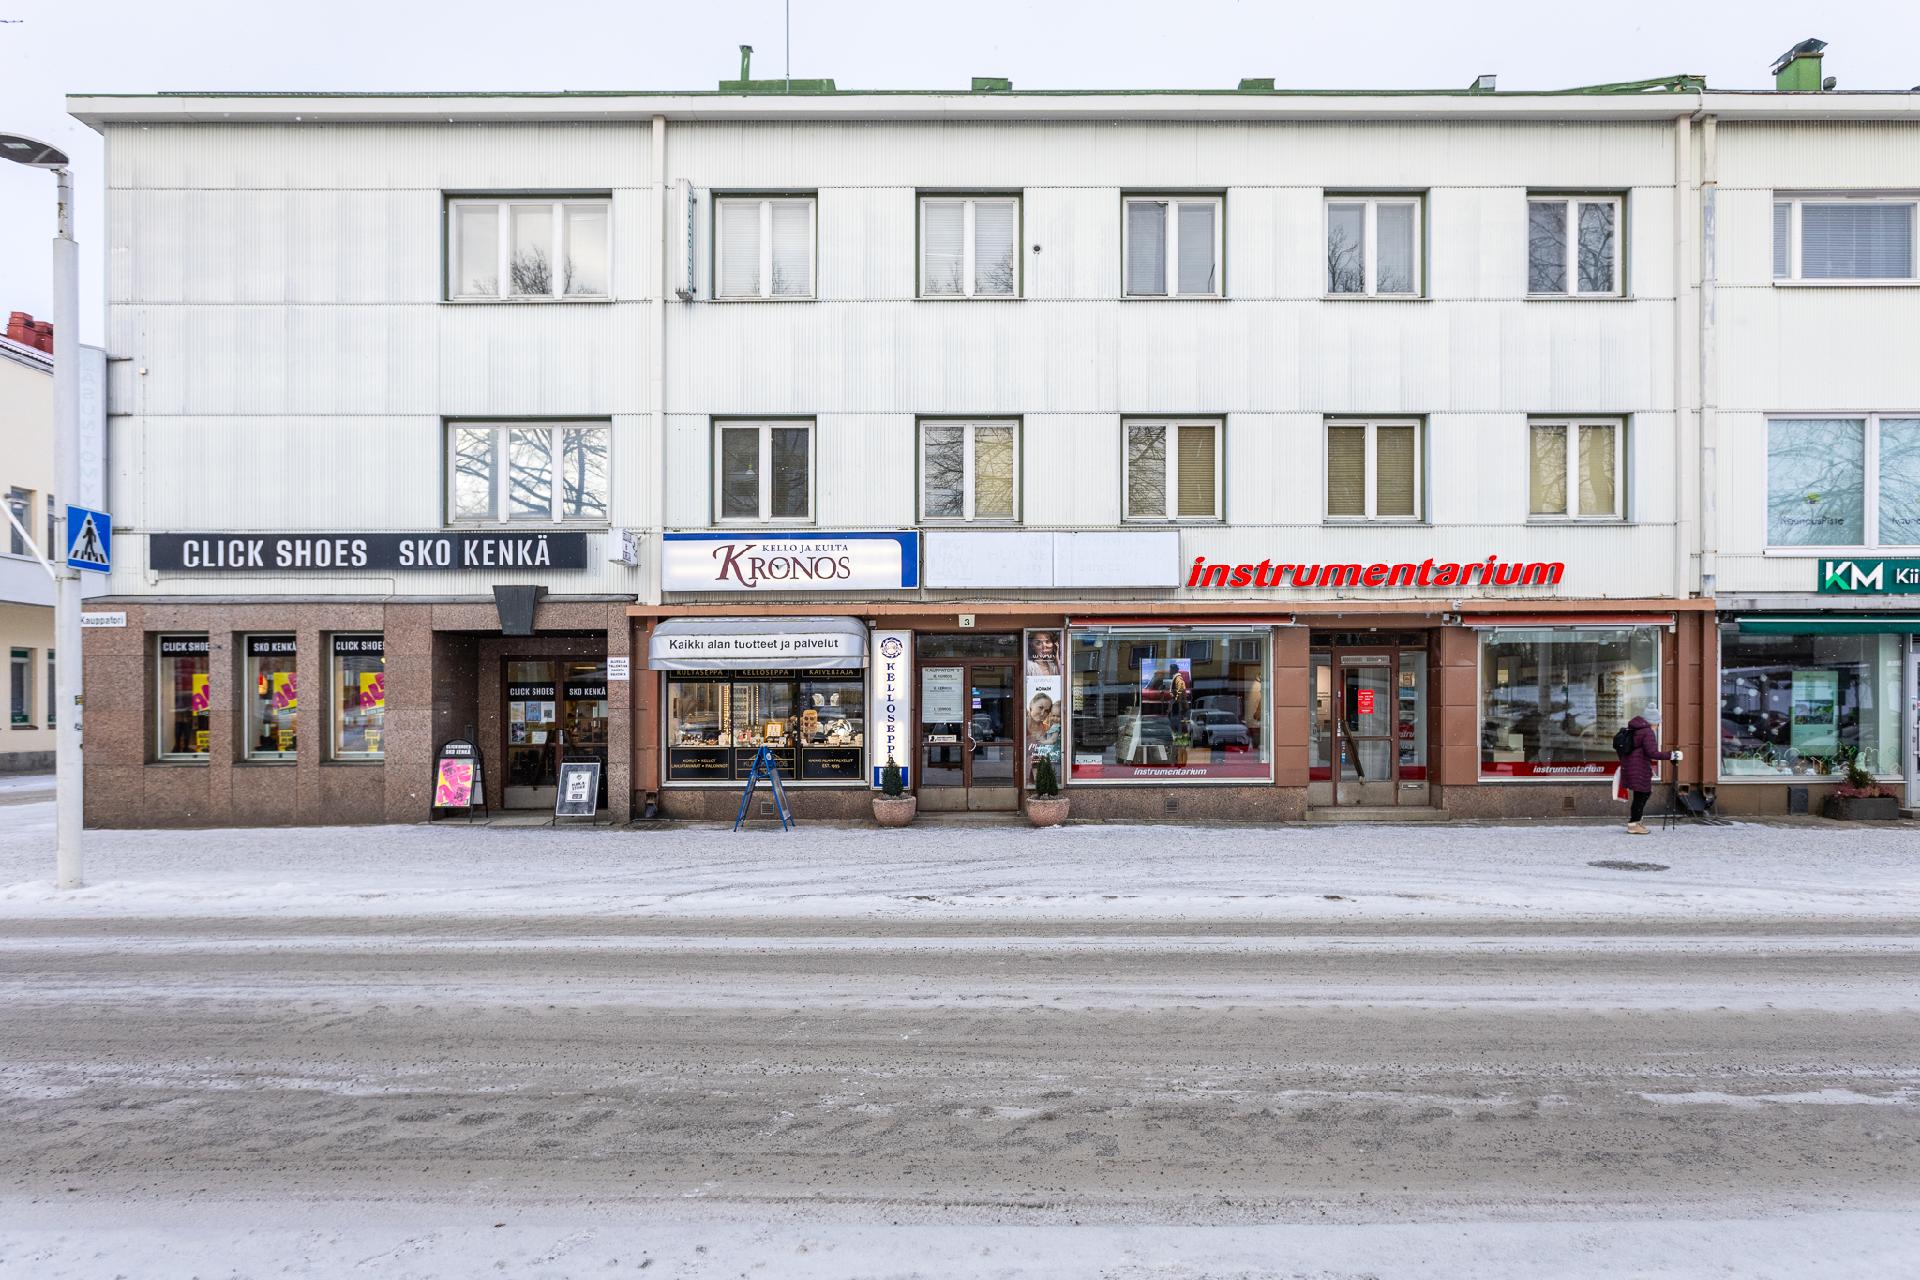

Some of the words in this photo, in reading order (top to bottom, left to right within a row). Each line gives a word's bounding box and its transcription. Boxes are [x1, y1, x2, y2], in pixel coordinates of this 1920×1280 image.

[183, 539, 264, 568] CLICK
[276, 538, 367, 567] SHOES
[399, 539, 451, 566] SKO
[464, 534, 551, 566] KENKÄ
[762, 544, 796, 552] KELLO
[800, 544, 813, 553] JA
[712, 544, 851, 588] KRONOS
[1187, 555, 1565, 587] instrumentarium
[1825, 561, 1883, 590] KM
[80, 615, 124, 625] Kauppatori
[964, 618, 970, 626] 3
[162, 642, 187, 651] CLICK
[254, 642, 269, 651] SKO
[335, 640, 359, 651] CLICK
[361, 640, 385, 651] SHOE
[669, 639, 705, 650] Kaikki
[707, 639, 731, 649] alan
[734, 639, 778, 649] tuotteet
[781, 639, 791, 651] ja
[794, 638, 839, 651] palvelut
[510, 687, 530, 696] CLICK
[532, 687, 554, 696] SHOES
[569, 687, 582, 696] SKO
[584, 686, 606, 696] KENKÄ
[1134, 767, 1207, 776] instrumentarium
[1533, 765, 1605, 773] instrumentarium
